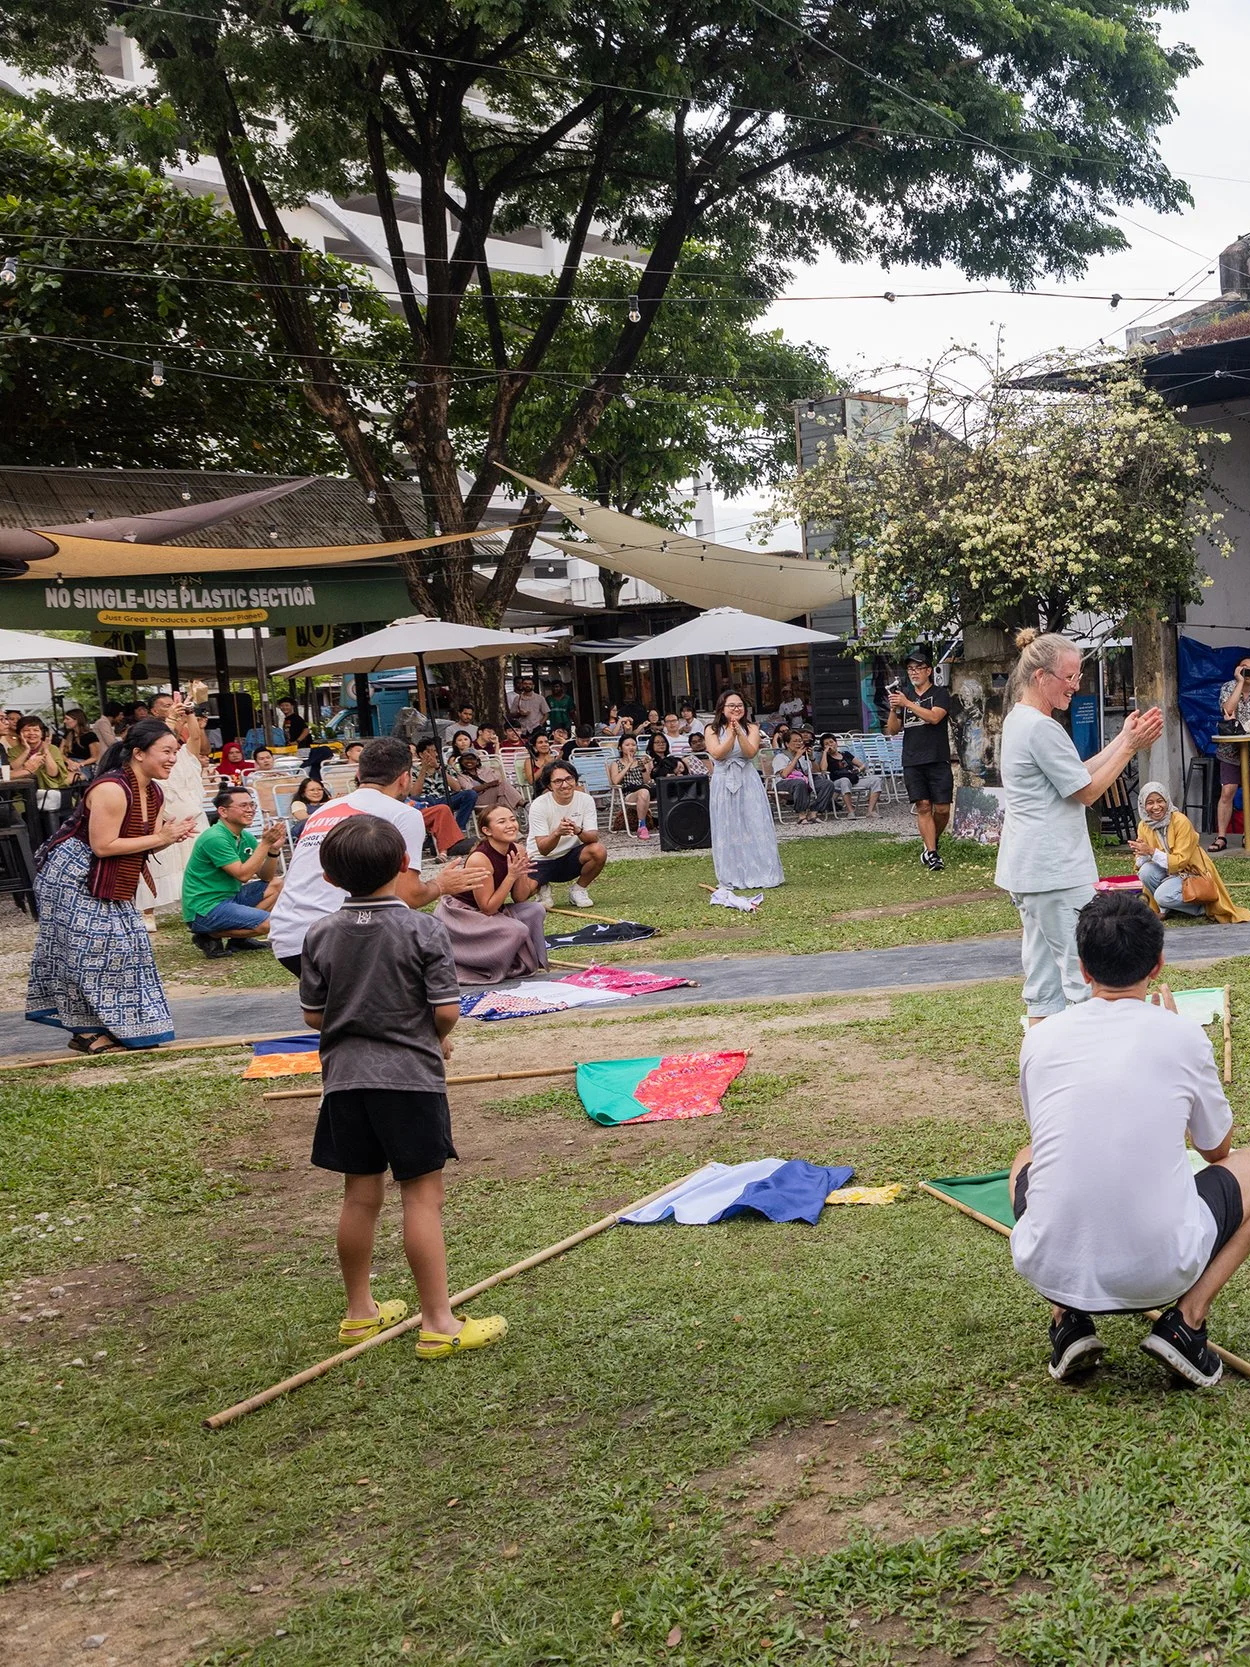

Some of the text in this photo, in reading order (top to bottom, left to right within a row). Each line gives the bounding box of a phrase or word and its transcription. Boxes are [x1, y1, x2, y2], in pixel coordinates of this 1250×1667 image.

[45, 586, 316, 609] NO SINGLE-USE PLASTIC SECTION
[123, 615, 149, 623] Great
[150, 615, 188, 623] Products
[190, 615, 197, 623] &
[205, 614, 236, 623] Cleaner
[236, 611, 264, 620] Planet!
